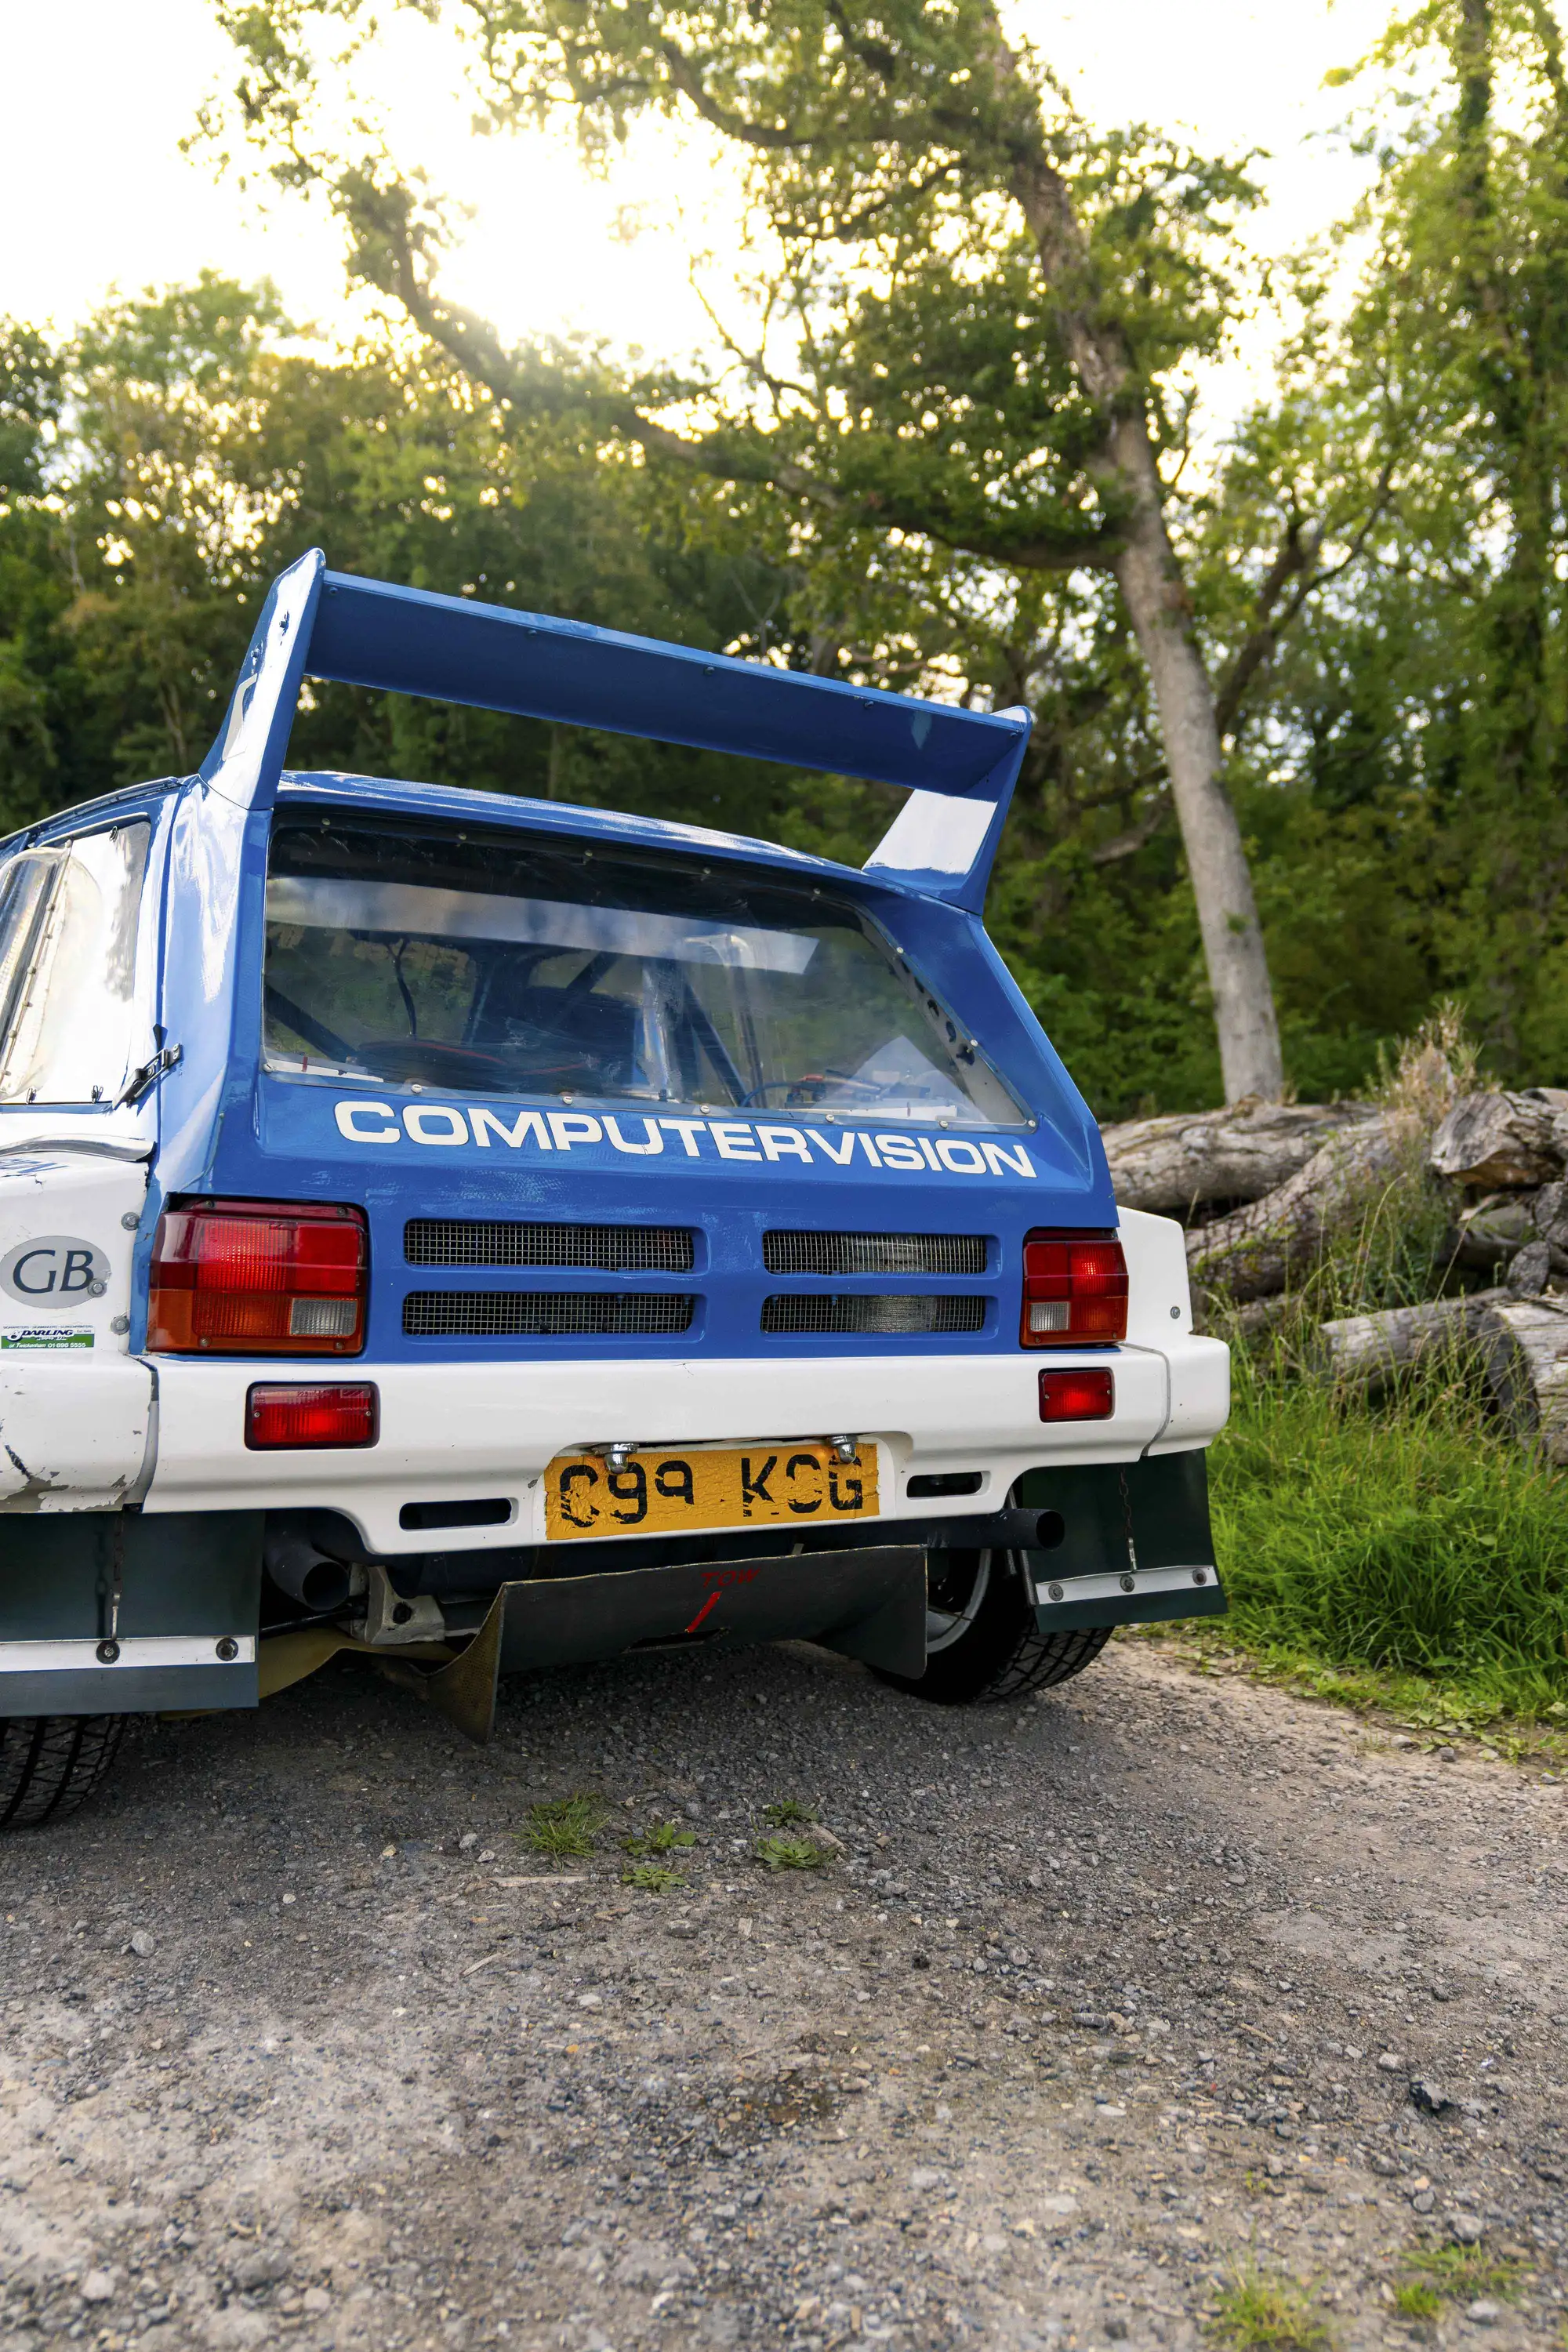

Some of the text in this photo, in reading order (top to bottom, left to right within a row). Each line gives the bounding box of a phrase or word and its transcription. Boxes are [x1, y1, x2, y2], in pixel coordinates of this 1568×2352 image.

[335, 1101, 1038, 1179] COMPUTERVISION
[13, 1249, 94, 1294] GB
[560, 1460, 695, 1528] C99
[700, 1566, 761, 1588] TOW
